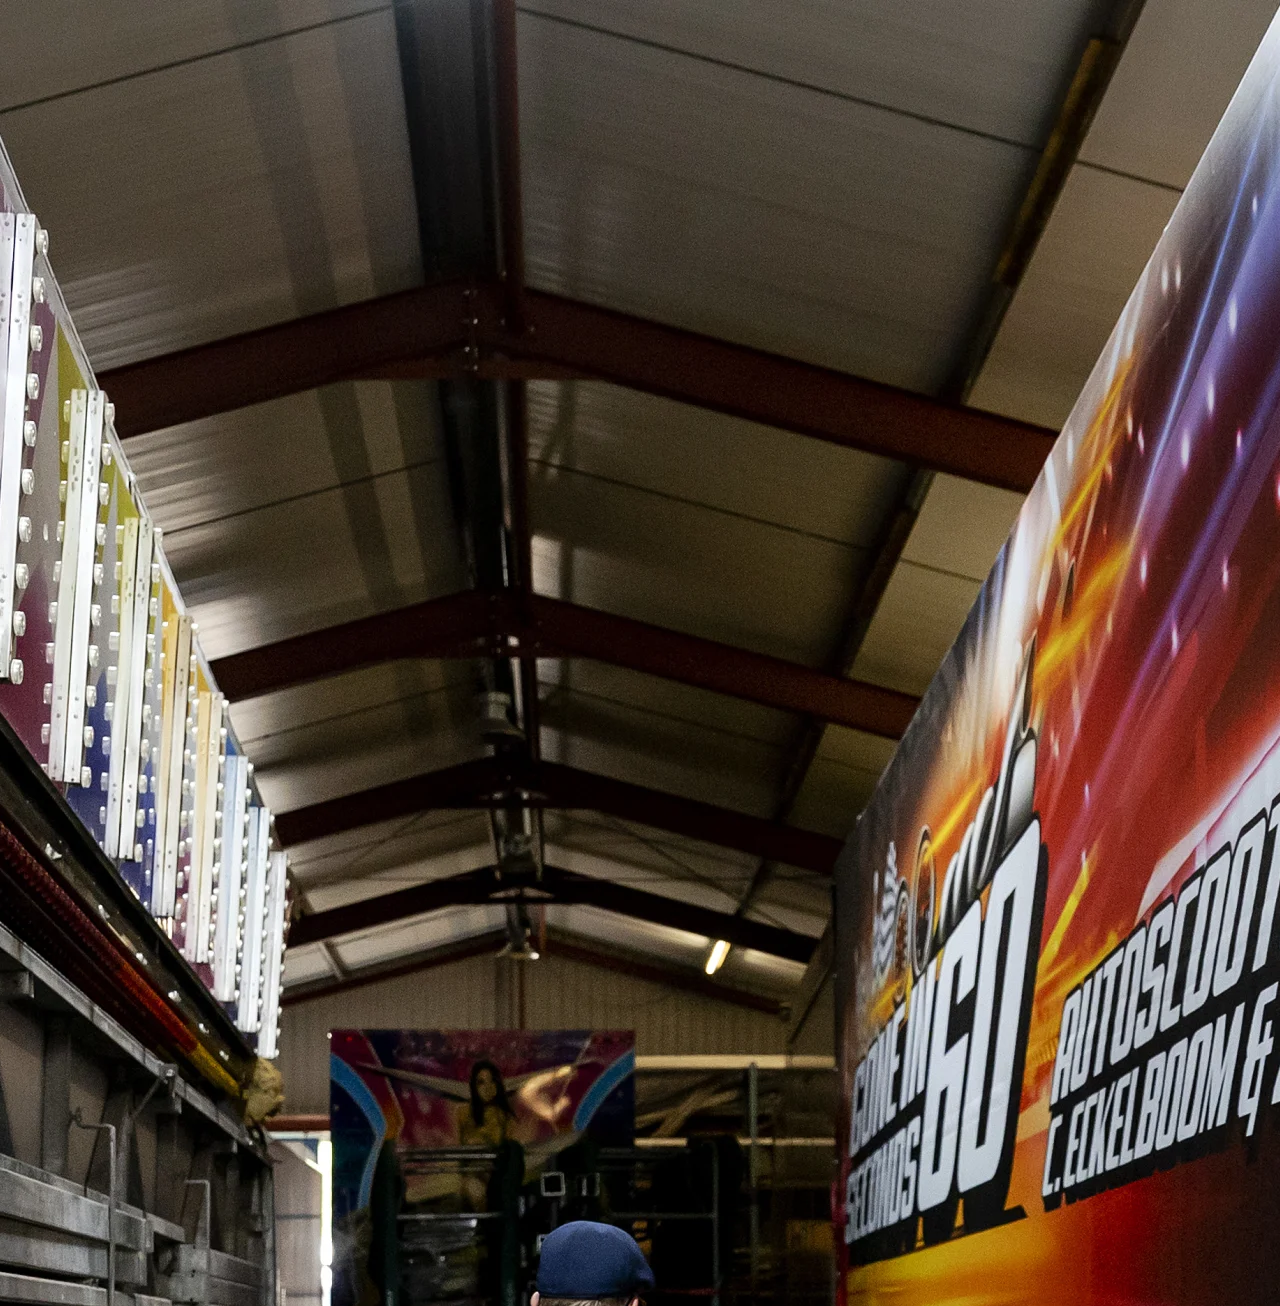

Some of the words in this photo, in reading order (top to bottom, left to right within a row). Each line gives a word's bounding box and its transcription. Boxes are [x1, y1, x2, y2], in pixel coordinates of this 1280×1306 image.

[849, 1001, 908, 1159] GONE
[900, 958, 937, 1111] IN
[917, 818, 1040, 1213] 60
[1238, 981, 1279, 1137] &
[845, 1115, 921, 1245] SECONDS
